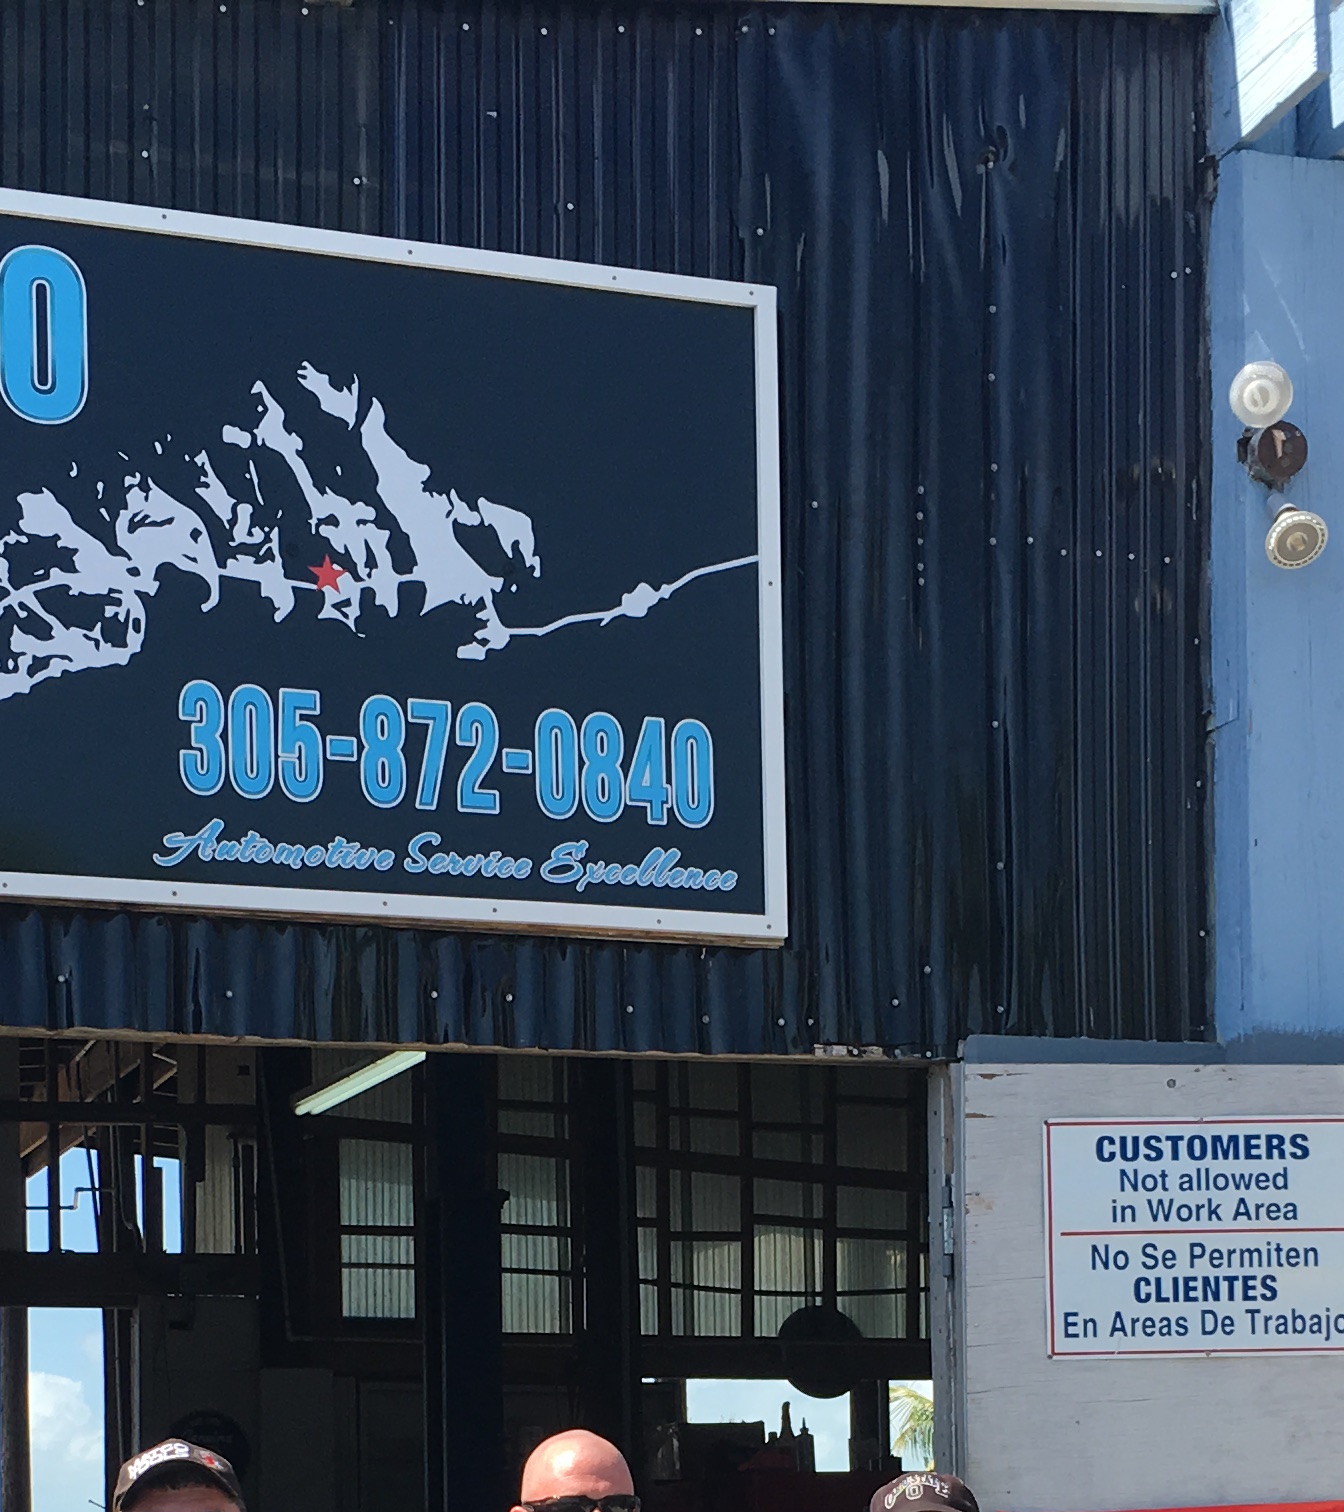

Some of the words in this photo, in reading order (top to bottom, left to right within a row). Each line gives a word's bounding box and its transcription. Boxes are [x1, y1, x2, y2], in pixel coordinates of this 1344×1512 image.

[178, 679, 714, 829] 305-872-0840
[153, 818, 394, 868] Automotive
[402, 832, 533, 880] Service
[540, 838, 738, 893] Excellence
[1095, 1133, 1310, 1162] CUSTOMERS
[1119, 1168, 1168, 1192] Not
[1178, 1167, 1289, 1191] allowed
[1111, 1199, 1136, 1223] in
[1147, 1198, 1223, 1222] Work
[1232, 1197, 1298, 1221] Area
[1090, 1244, 1130, 1271] No
[1141, 1242, 1178, 1270] Se
[1189, 1241, 1320, 1269] Permiten
[1133, 1274, 1278, 1303] CLIENTES
[1063, 1311, 1098, 1339] En
[1109, 1310, 1189, 1338] Areas
[1200, 1309, 1235, 1336] De
